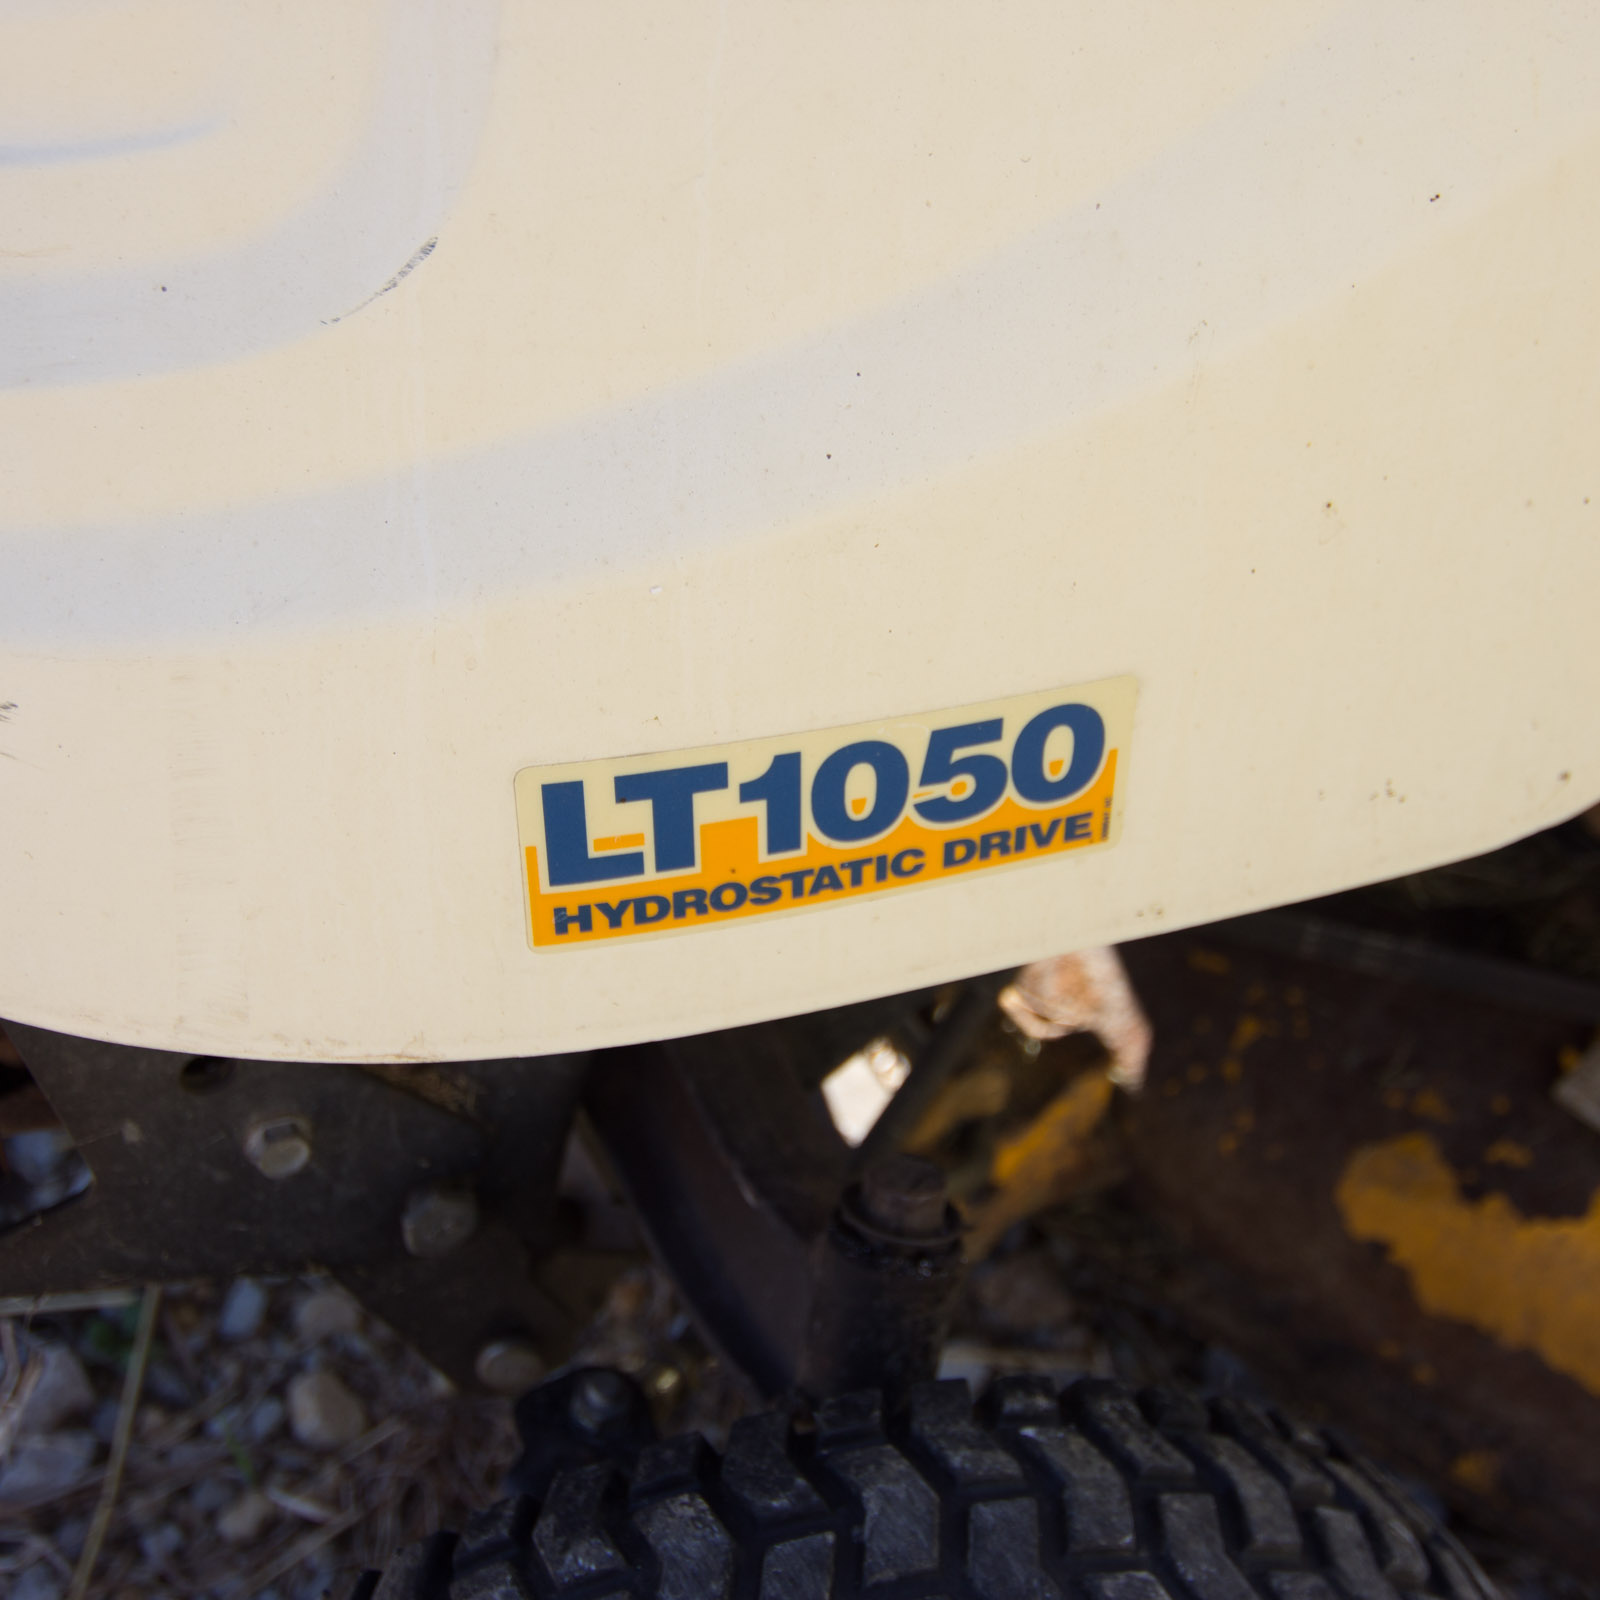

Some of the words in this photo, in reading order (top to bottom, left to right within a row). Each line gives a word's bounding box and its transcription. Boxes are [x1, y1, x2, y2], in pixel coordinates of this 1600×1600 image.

[541, 703, 1105, 887] LT1050
[553, 848, 924, 935] HYDROSTATIC
[943, 812, 1093, 868] DRIVE
